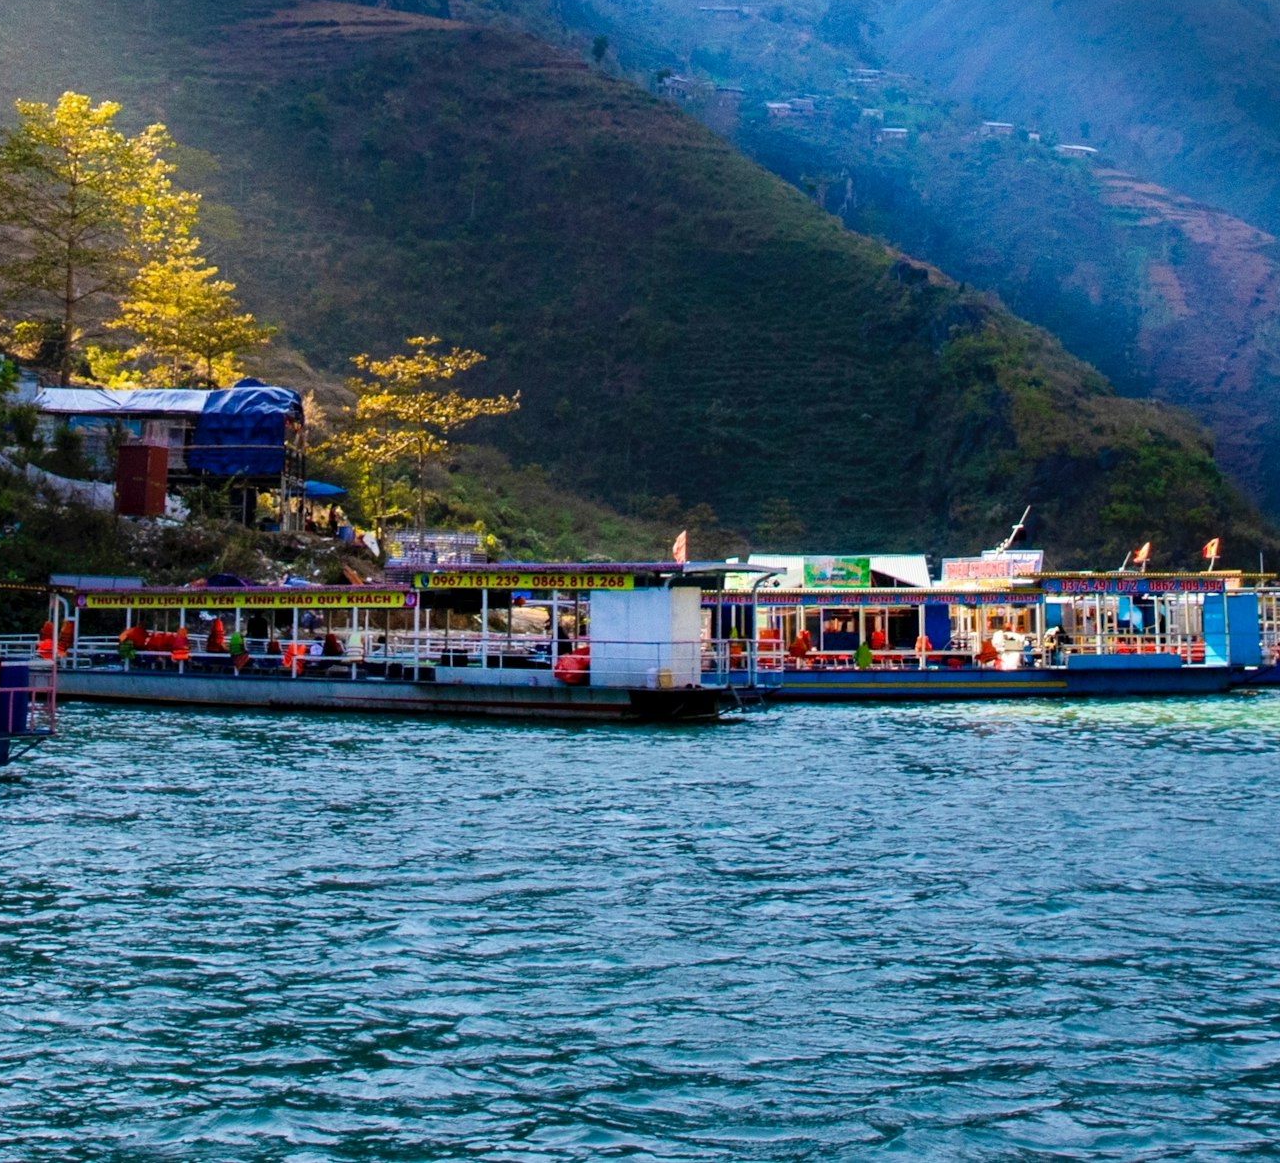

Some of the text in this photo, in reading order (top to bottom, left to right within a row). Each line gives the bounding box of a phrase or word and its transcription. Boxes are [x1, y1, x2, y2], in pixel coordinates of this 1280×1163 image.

[432, 576, 520, 586] 0967.181.239
[532, 576, 625, 587] 0865.818.268
[139, 597, 154, 605] DU
[158, 597, 183, 607] LỊCH
